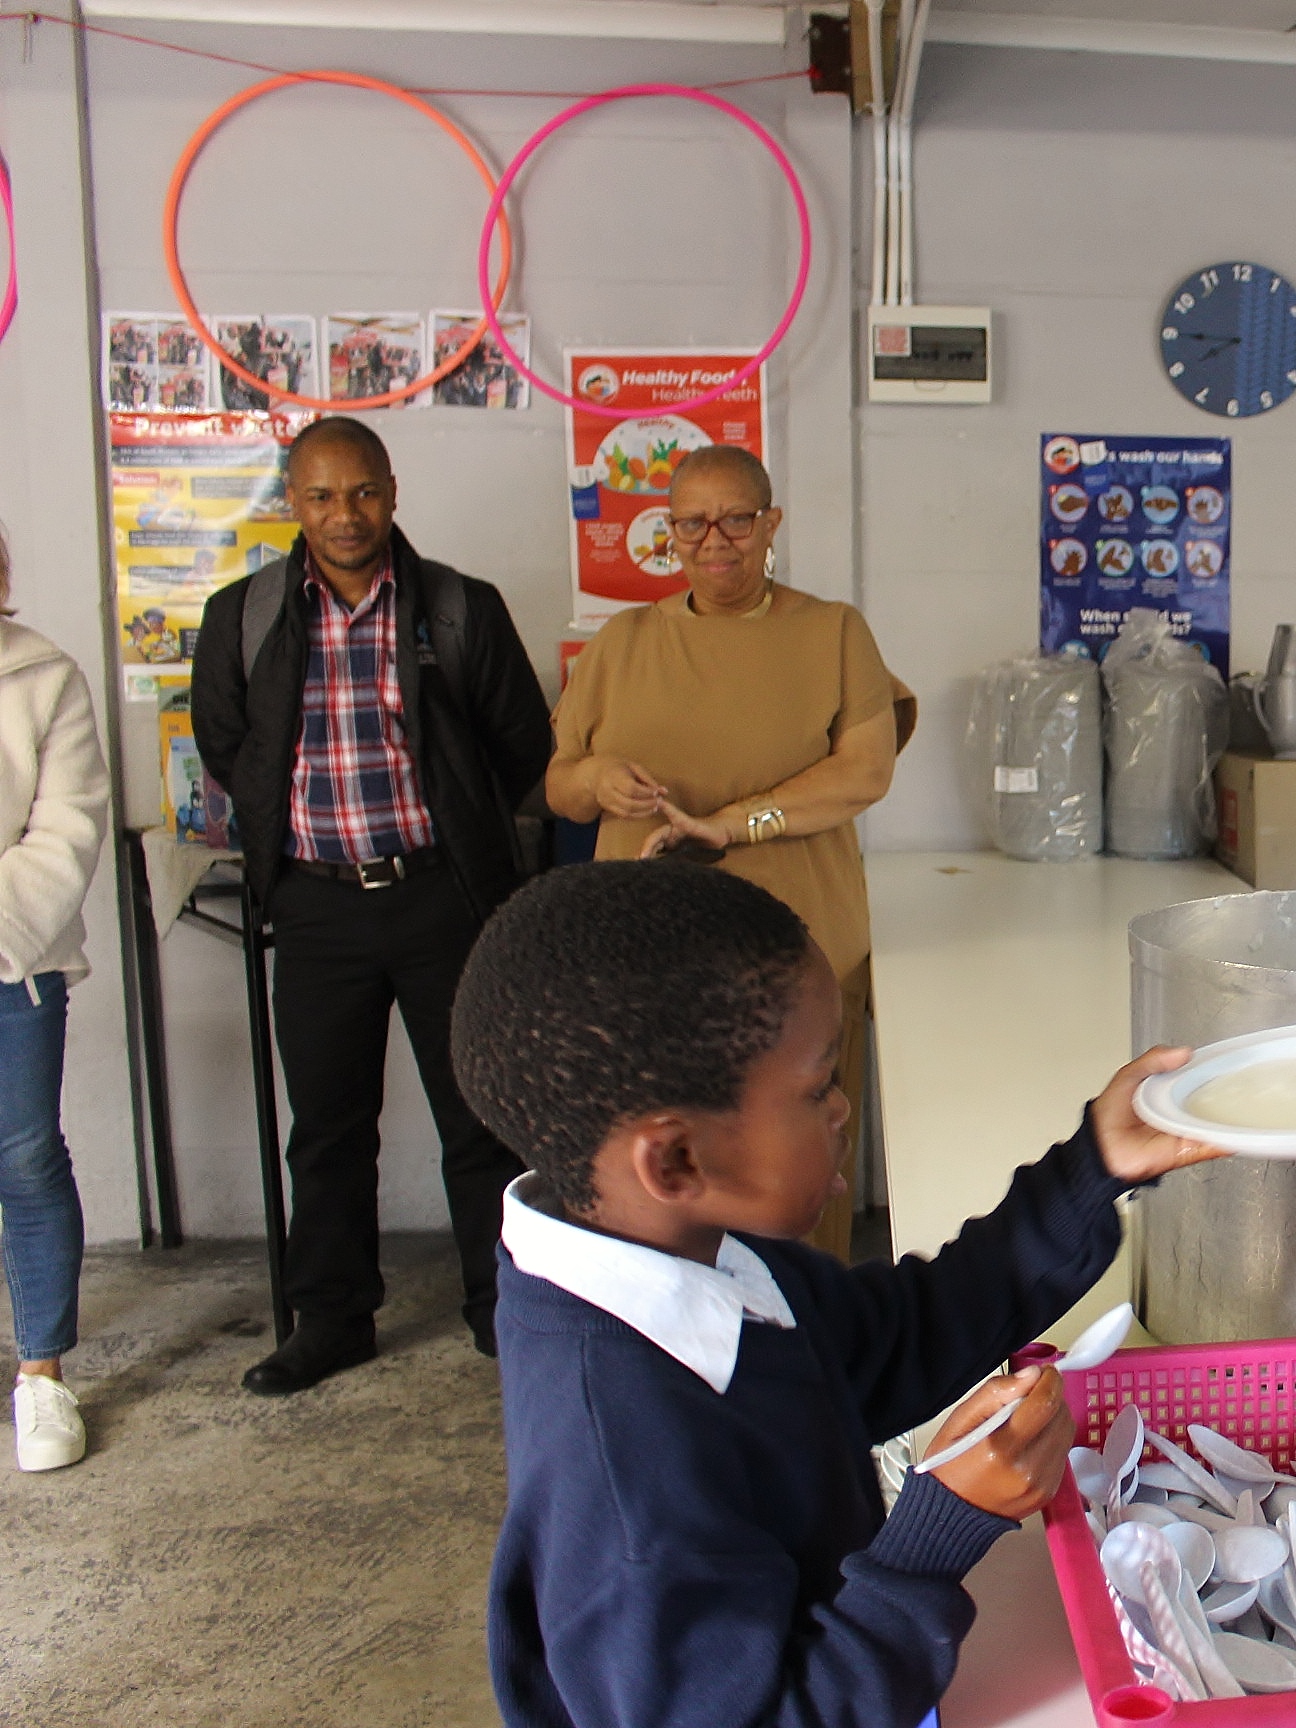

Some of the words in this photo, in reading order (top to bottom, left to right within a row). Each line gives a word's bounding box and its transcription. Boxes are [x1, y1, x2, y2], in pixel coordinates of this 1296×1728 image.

[1200, 270, 1219, 287] 11
[1232, 264, 1252, 282] 12
[1270, 277, 1281, 293] 1
[1174, 292, 1195, 314] 10
[1162, 326, 1179, 340] 9
[1169, 361, 1185, 378] 8
[622, 369, 688, 388] Healthy
[1194, 387, 1209, 404] 7
[1227, 399, 1239, 416] 6
[1118, 449, 1155, 463] wash
[1156, 451, 1180, 464] our
[1182, 449, 1224, 466] hands
[1080, 608, 1120, 623] When
[1171, 611, 1192, 623] we
[1080, 622, 1115, 635] wash
